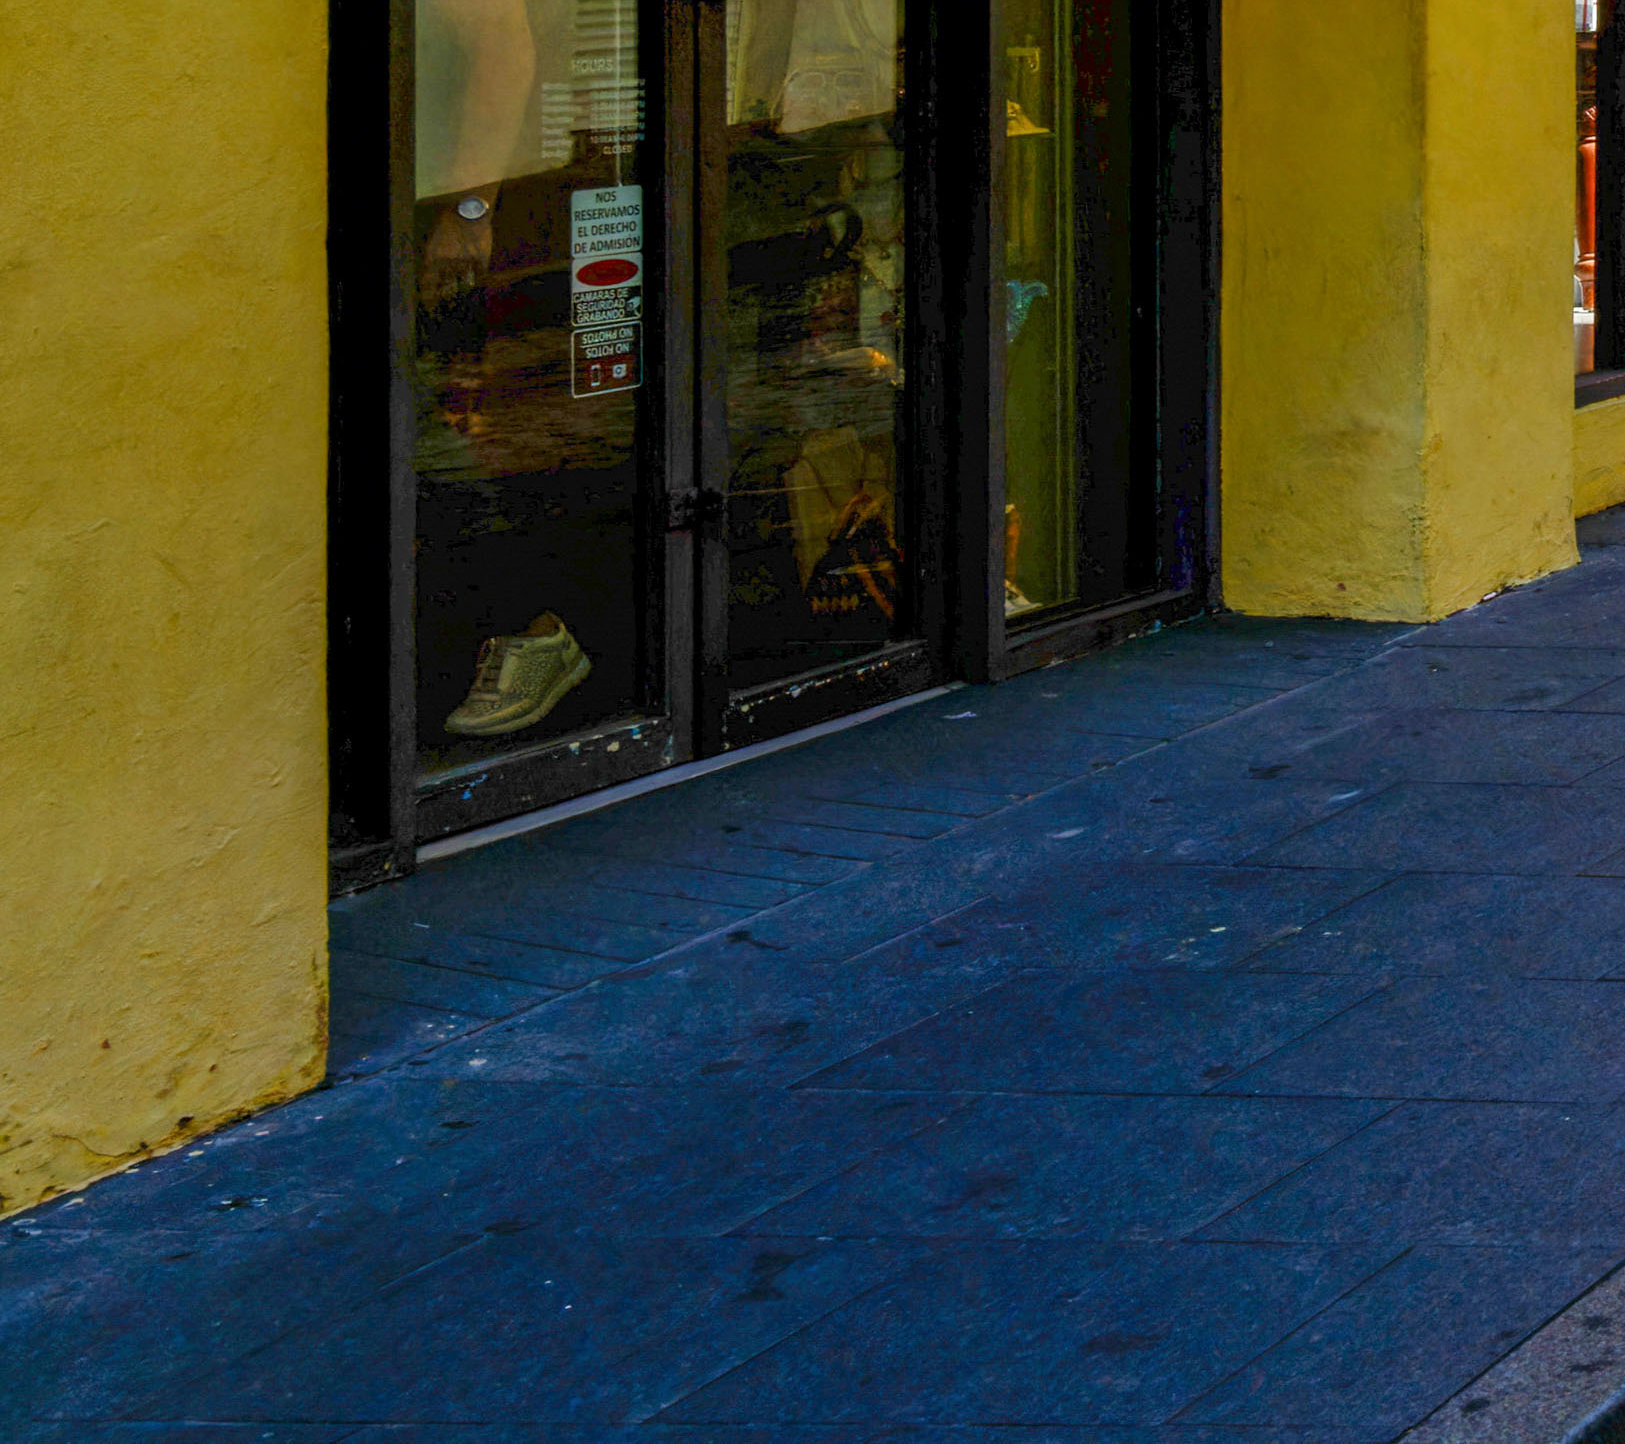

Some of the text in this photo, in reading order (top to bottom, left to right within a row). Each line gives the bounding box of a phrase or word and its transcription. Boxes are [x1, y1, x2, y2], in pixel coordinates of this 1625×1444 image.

[595, 191, 617, 203] NOS
[574, 204, 640, 221] RESERVAMOS
[577, 221, 637, 238] EL DERECHO
[574, 242, 587, 254] DE
[617, 287, 629, 298] DE
[576, 298, 626, 313] SEGURIDAD
[577, 309, 625, 323] GRABANDO
